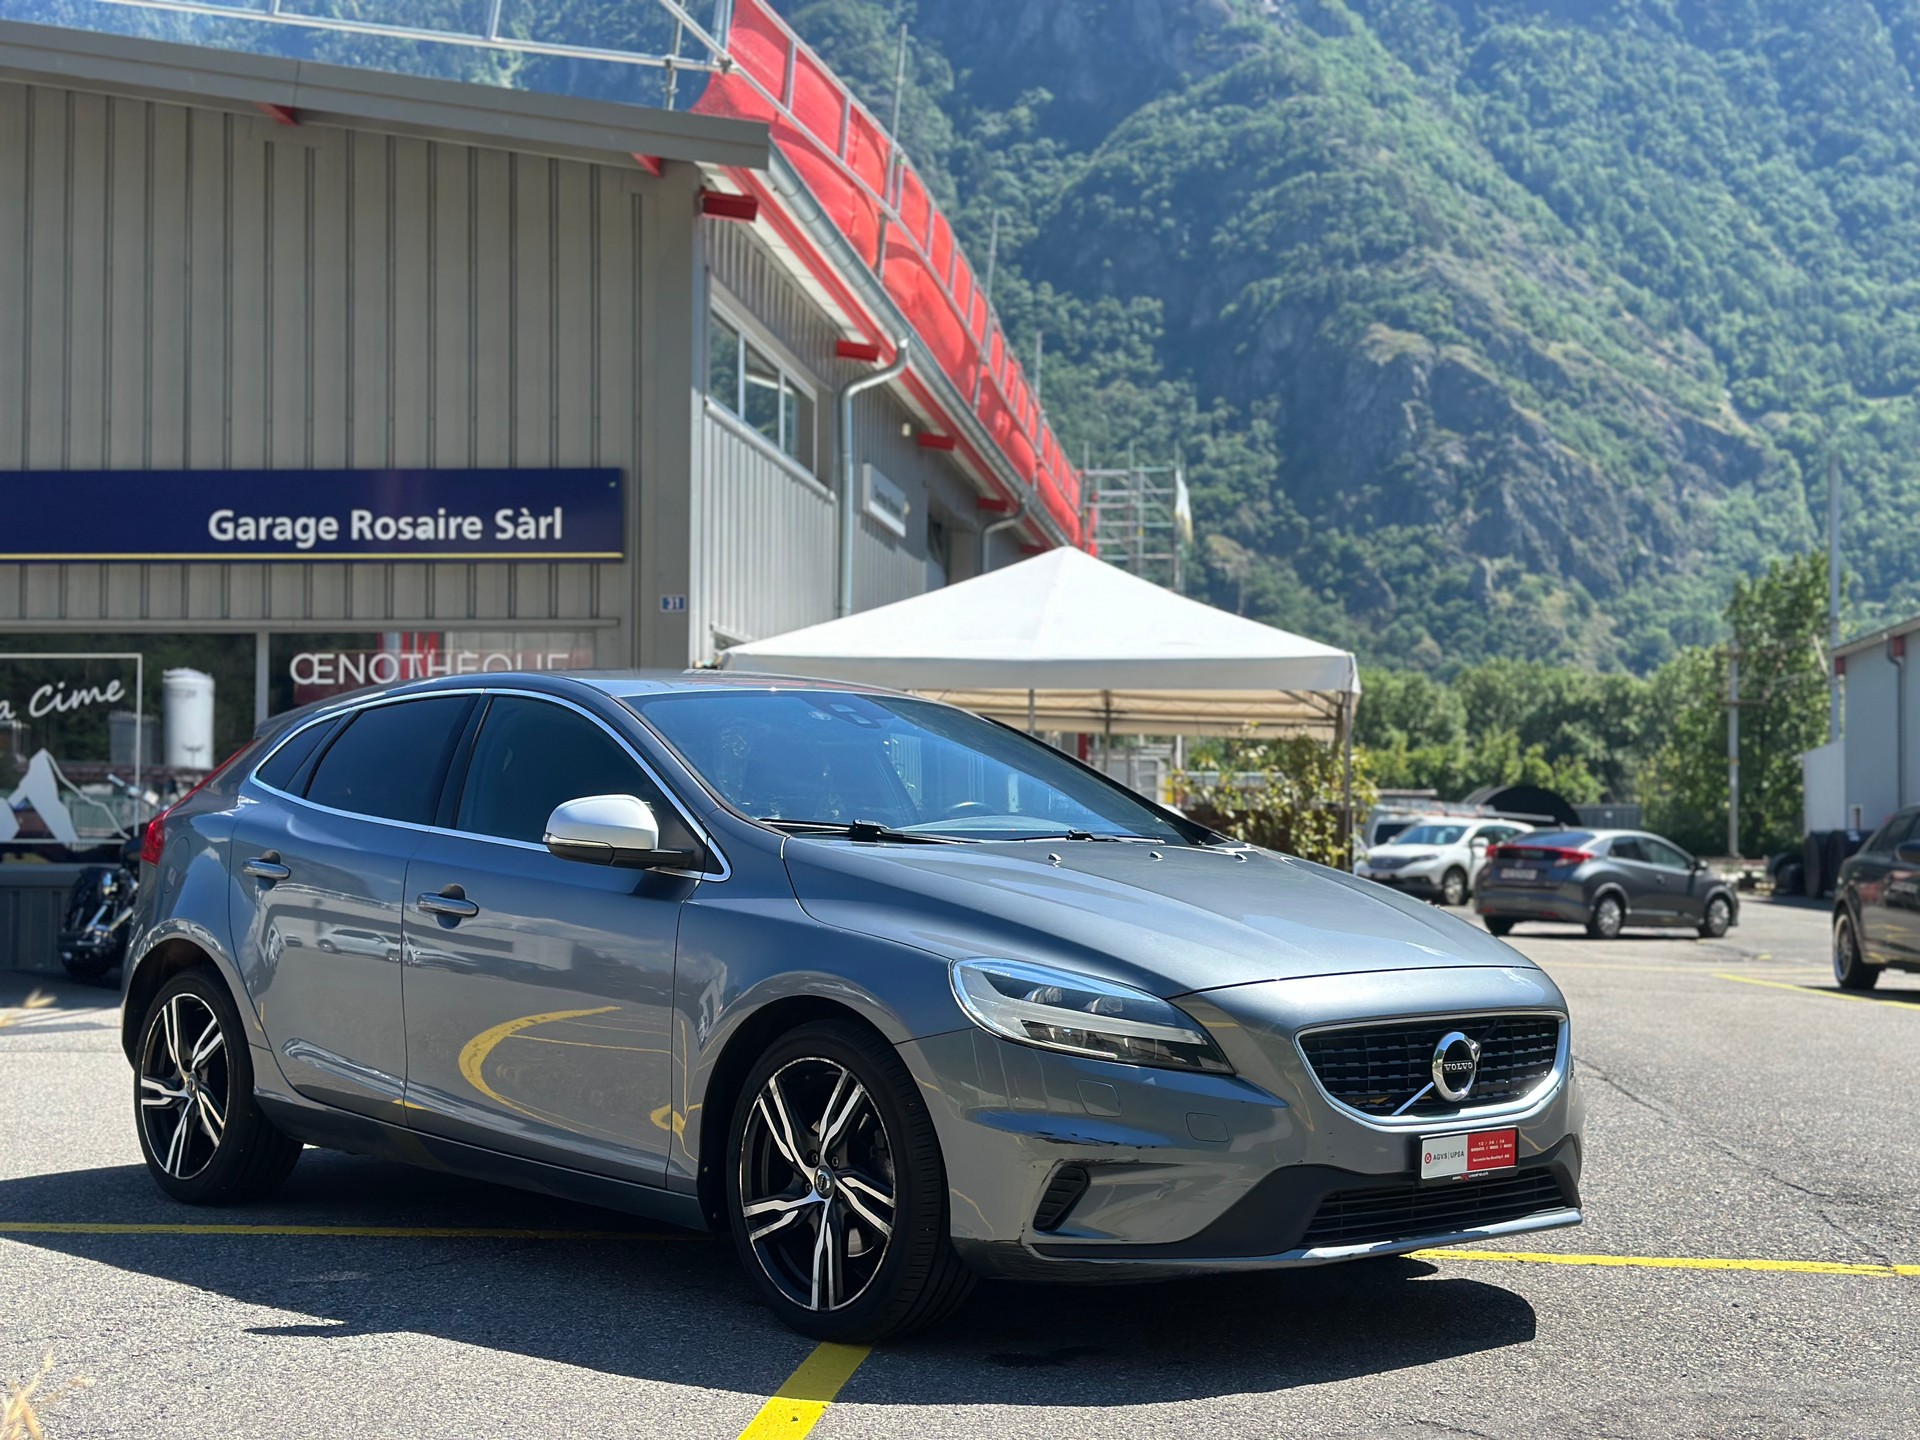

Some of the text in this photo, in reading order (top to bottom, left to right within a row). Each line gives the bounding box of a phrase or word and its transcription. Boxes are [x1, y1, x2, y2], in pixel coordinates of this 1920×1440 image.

[208, 506, 562, 549] Garage Rosaire Sàrl
[29, 679, 126, 718] Cime
[1443, 1062, 1474, 1071] VOLVO
